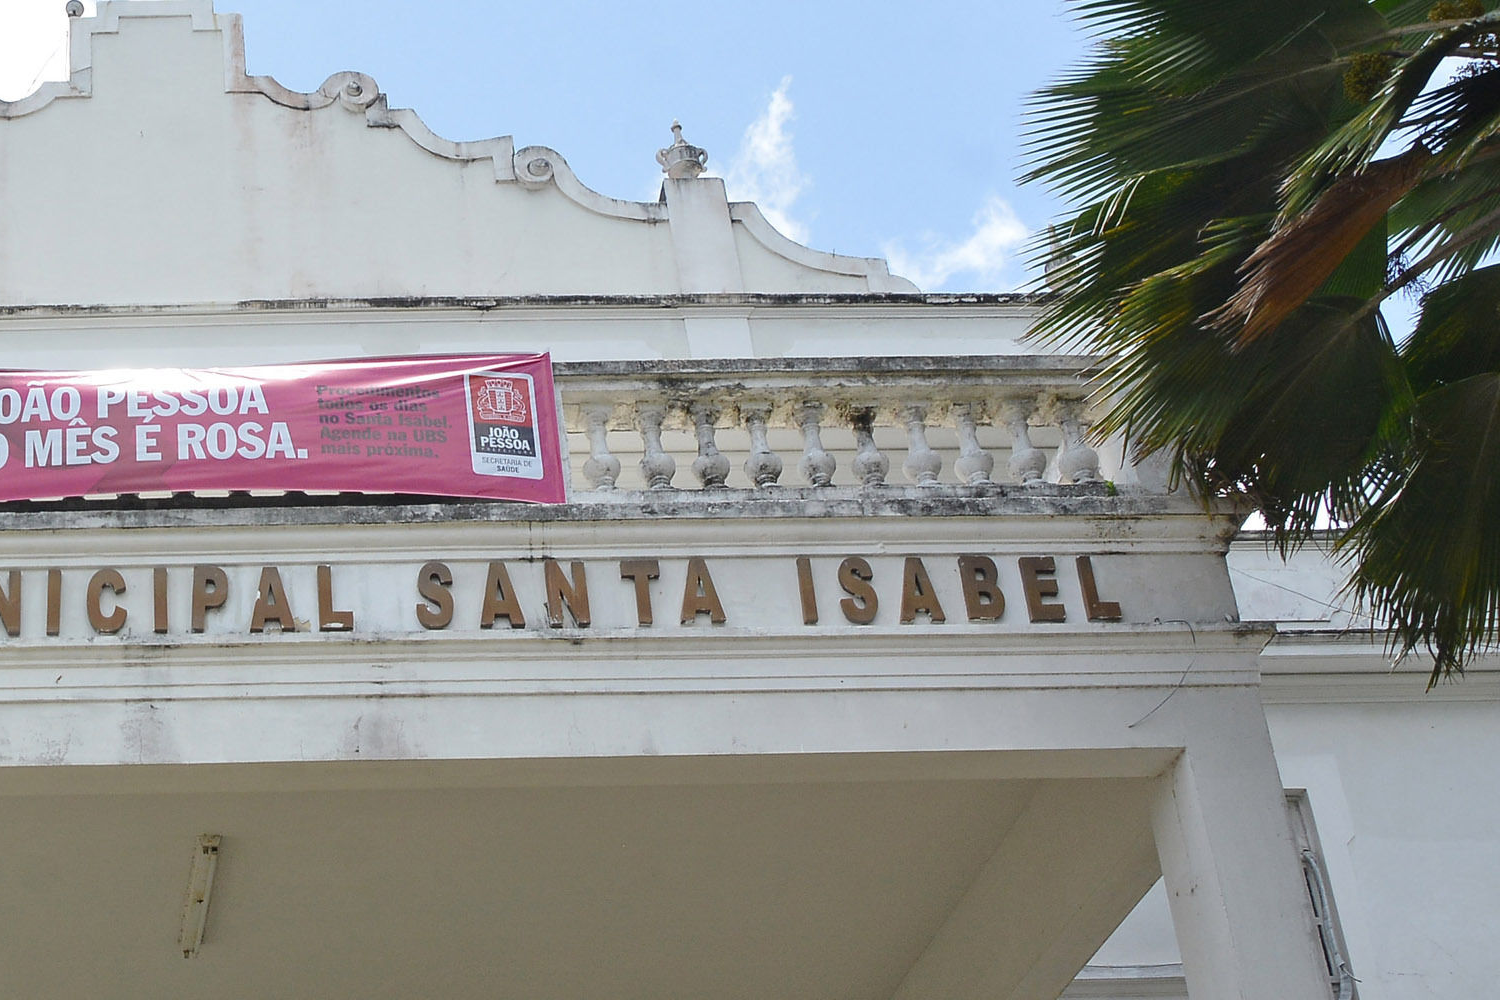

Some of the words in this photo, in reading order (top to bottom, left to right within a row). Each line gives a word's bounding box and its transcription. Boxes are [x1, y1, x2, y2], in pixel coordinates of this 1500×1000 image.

[97, 383, 269, 418] PESSOA
[318, 398, 365, 410] todos
[369, 402, 388, 411] os
[394, 400, 428, 412] dias
[320, 414, 339, 424] no
[345, 412, 393, 425] Santa
[398, 414, 453, 428] Isabel.
[25, 417, 120, 467] MÊS
[135, 414, 162, 461] É
[177, 422, 309, 460] ROSA.
[320, 426, 381, 441] Agende
[388, 431, 407, 441] na
[413, 429, 447, 443] UBS
[489, 426, 519, 439] JOÃO
[322, 442, 360, 454] mais
[367, 443, 439, 458] próxima.
[480, 436, 530, 451] PESSOA
[482, 456, 522, 466] SECRETARIA
[415, 557, 727, 630] SANTA
[795, 554, 1122, 625] ISABEL
